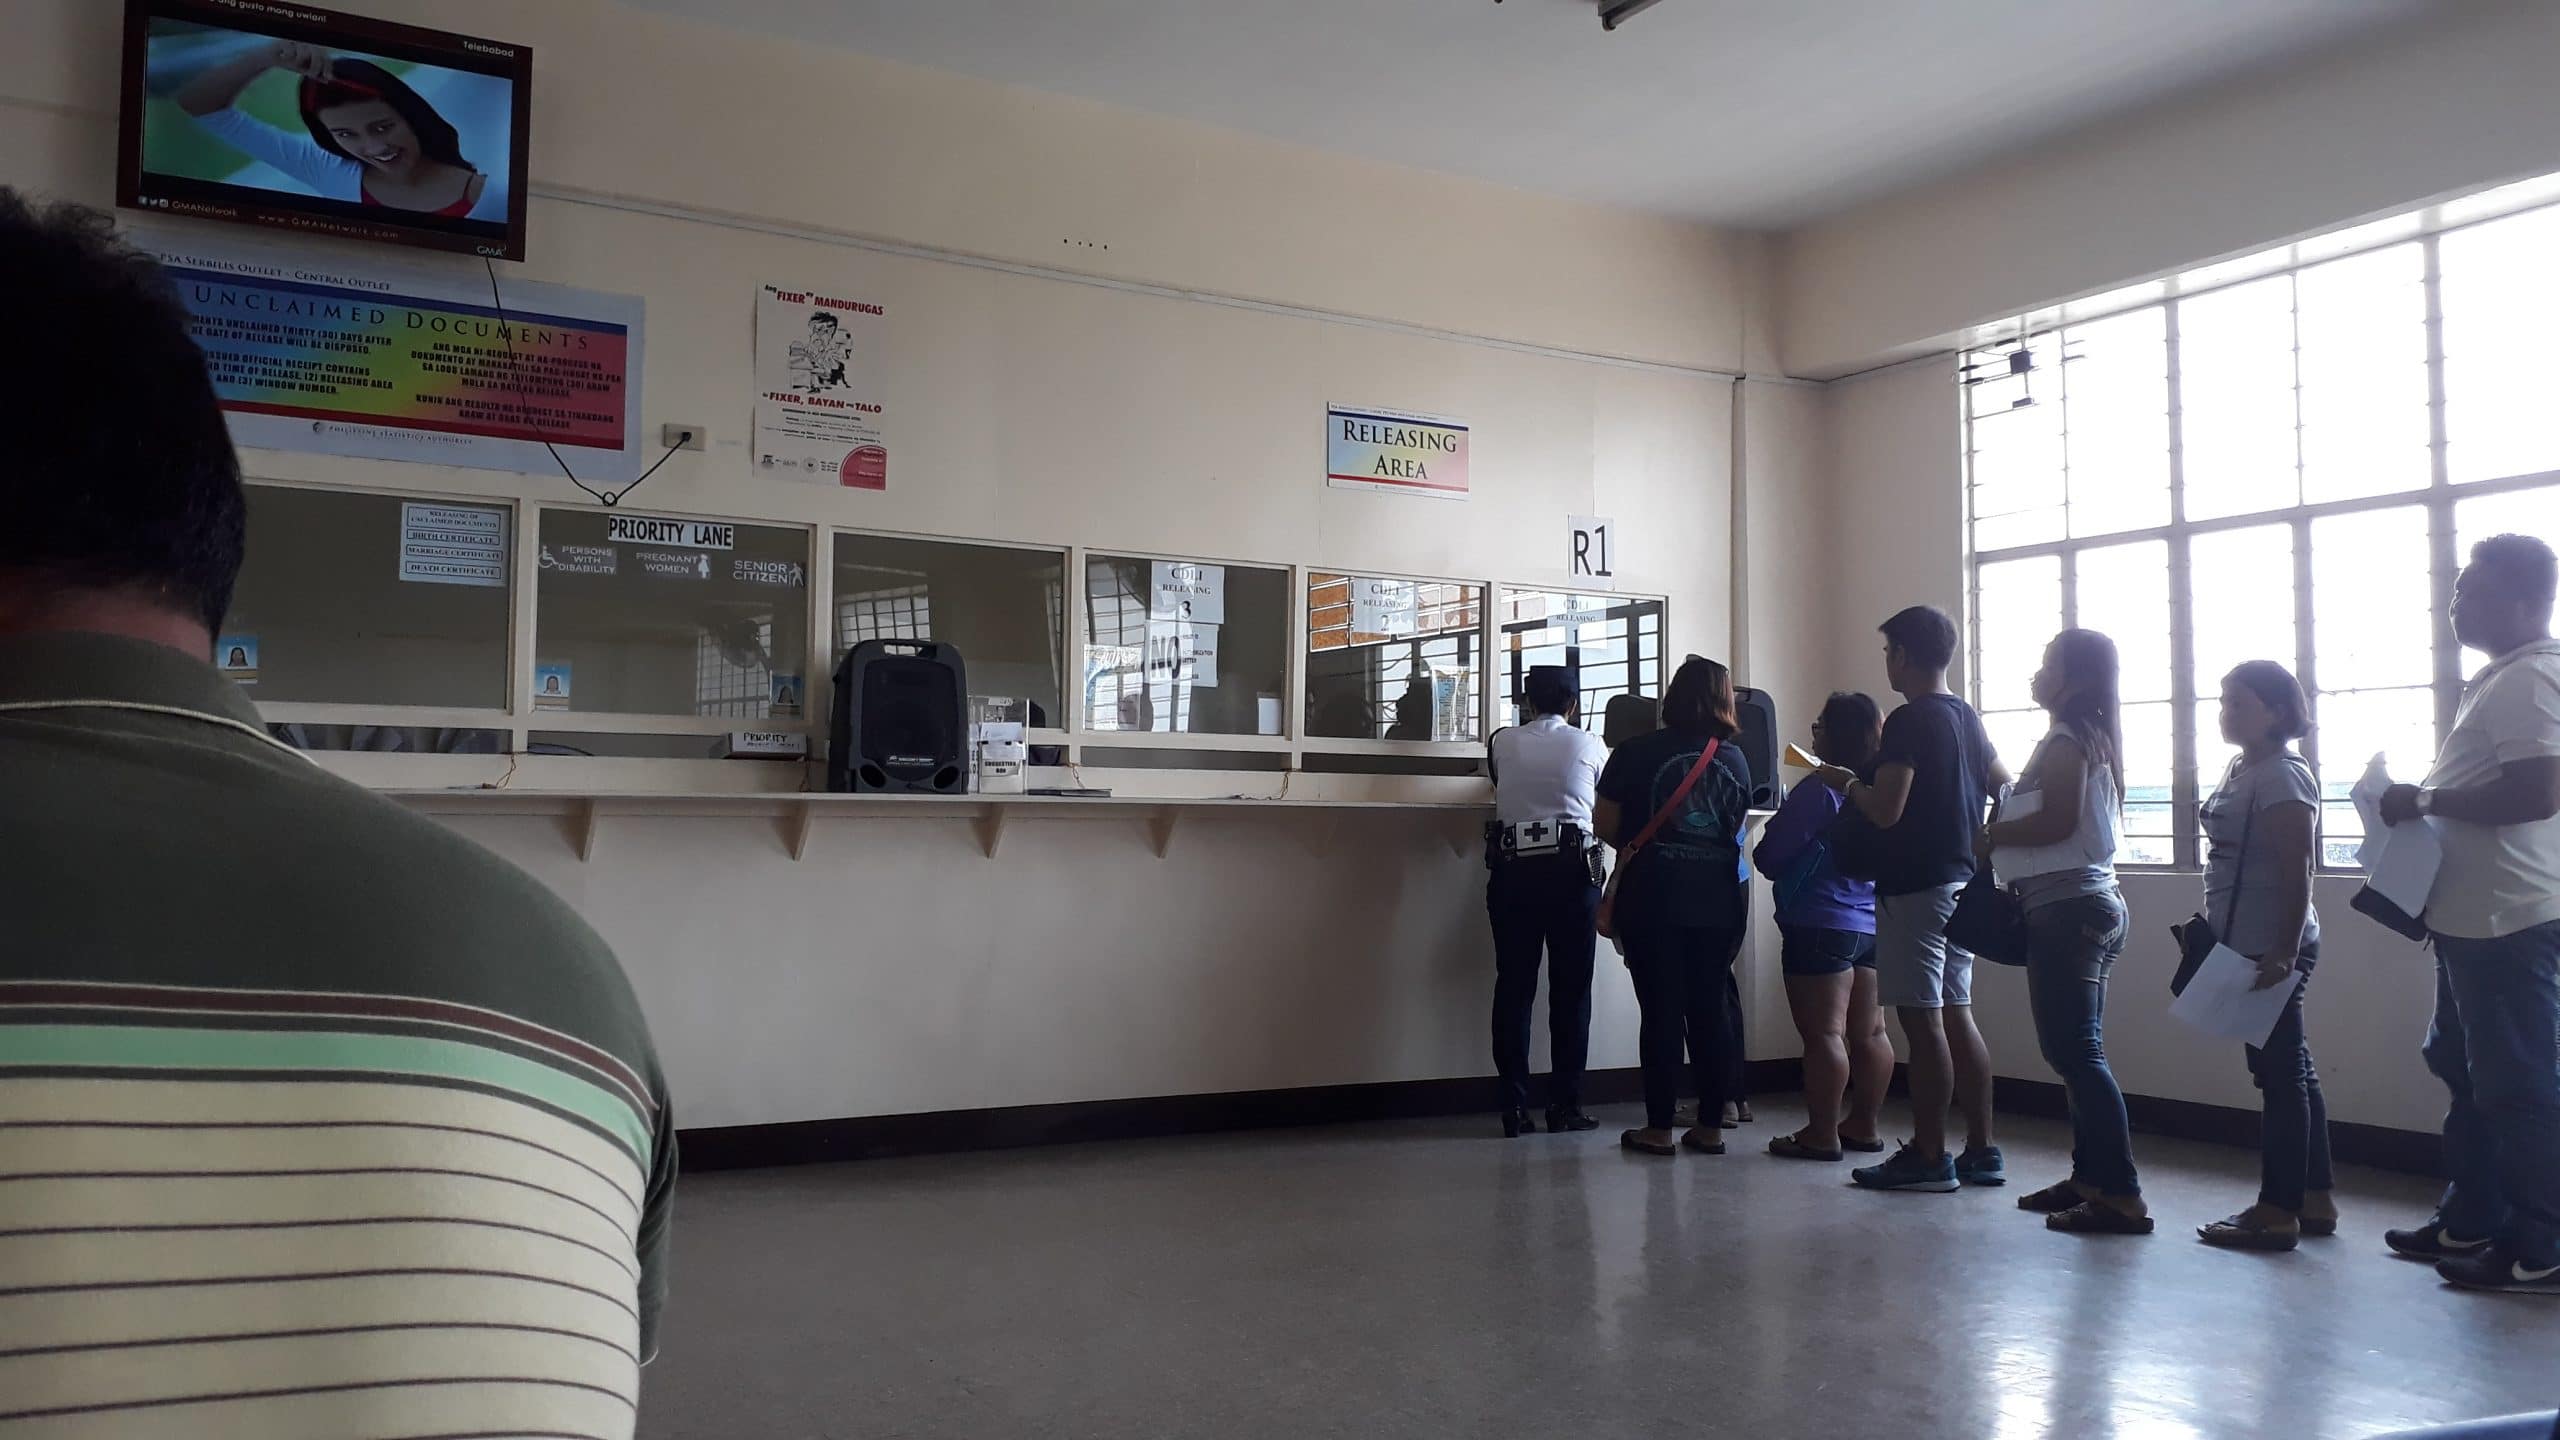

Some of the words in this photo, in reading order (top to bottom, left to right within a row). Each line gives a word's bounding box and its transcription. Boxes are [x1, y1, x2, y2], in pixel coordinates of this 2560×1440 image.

[239, 1, 265, 12] gusto
[267, 5, 294, 18] mong
[238, 263, 282, 277] OUTLET
[295, 270, 344, 285] CENTRAL
[348, 278, 391, 291] OUTLET
[777, 290, 805, 304] FIXER
[814, 296, 884, 316] MANDURUGAS
[195, 285, 385, 325] UNCLAIMED
[407, 312, 588, 350] DOCUMENTS
[206, 328, 228, 339] DATE
[231, 331, 242, 340] OF
[246, 333, 283, 345] RELEASE
[286, 337, 307, 348] WILL
[311, 340, 321, 349] BE
[226, 319, 280, 333] UNCLAIMED
[283, 326, 315, 338] THIRTY
[340, 332, 363, 344] DAYS
[366, 336, 392, 346] AFTER
[433, 342, 450, 353] ANG
[242, 354, 282, 367] OFFICIAL
[286, 359, 322, 371] RECEIPT
[326, 363, 370, 377] CONTAINS
[423, 362, 433, 371] SA
[216, 374, 235, 384] AND
[255, 378, 296, 391] WINDOW
[223, 363, 245, 374] TIME
[248, 366, 259, 375] OF
[321, 373, 368, 387] RELEASING
[371, 379, 394, 390] AREA
[808, 396, 845, 409] BAYAN
[855, 402, 882, 413] TALO
[1343, 419, 1456, 453] RELEASING
[1374, 454, 1428, 480] AREA
[609, 517, 685, 543] PRIORITY
[694, 525, 732, 547] LANE
[562, 545, 613, 557] PERSONS
[636, 552, 699, 565] PREGNANT
[1573, 525, 1612, 577] R1
[574, 556, 601, 564] WITH
[645, 562, 689, 574] WOMEN
[734, 560, 787, 574] SENIOR
[559, 562, 617, 576] DISABILITY
[733, 570, 788, 585] CITIZEN
[1181, 600, 1192, 619] 3
[1573, 629, 1578, 645] 1
[1151, 635, 1181, 680] NO
[743, 731, 788, 743] PRIORITY
